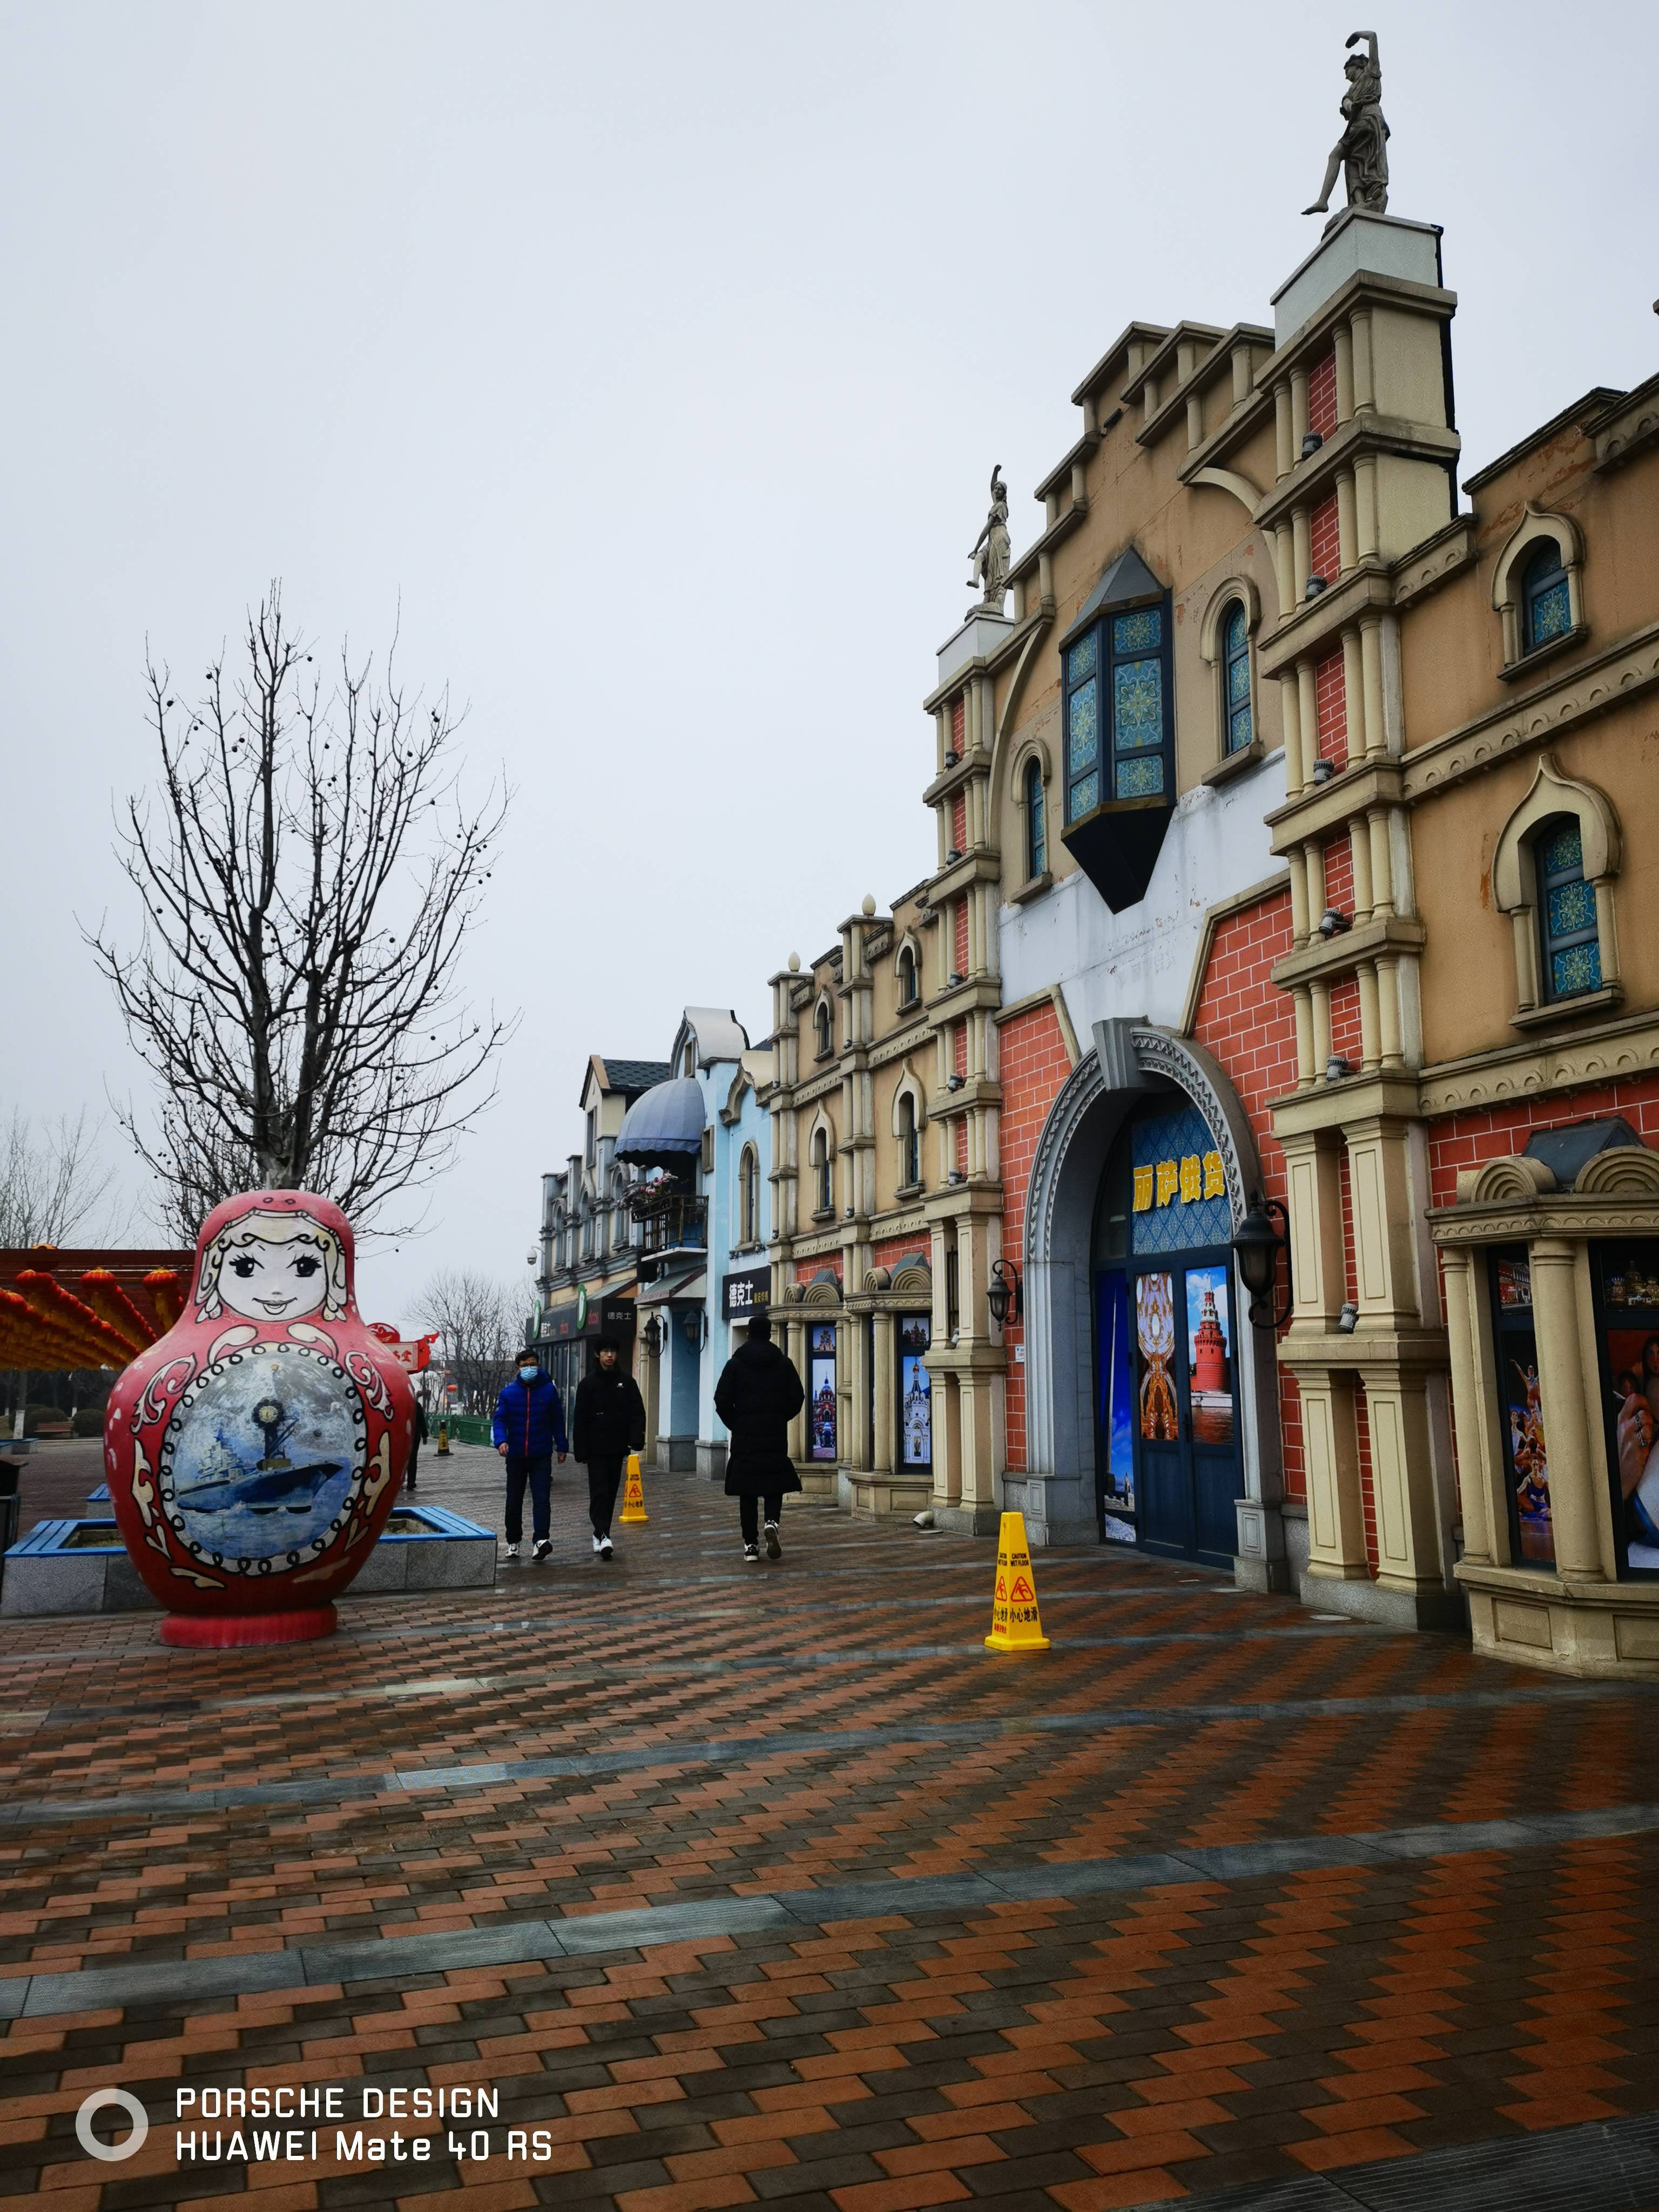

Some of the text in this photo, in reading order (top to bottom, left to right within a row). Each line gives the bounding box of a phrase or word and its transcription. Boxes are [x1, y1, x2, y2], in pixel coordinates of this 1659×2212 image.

[1132, 1150, 1225, 1212] 丽萨俄货
[729, 1279, 753, 1307] 德克士
[608, 1312, 632, 1320] 德克士
[1010, 1607, 1037, 1623] 小心地滑
